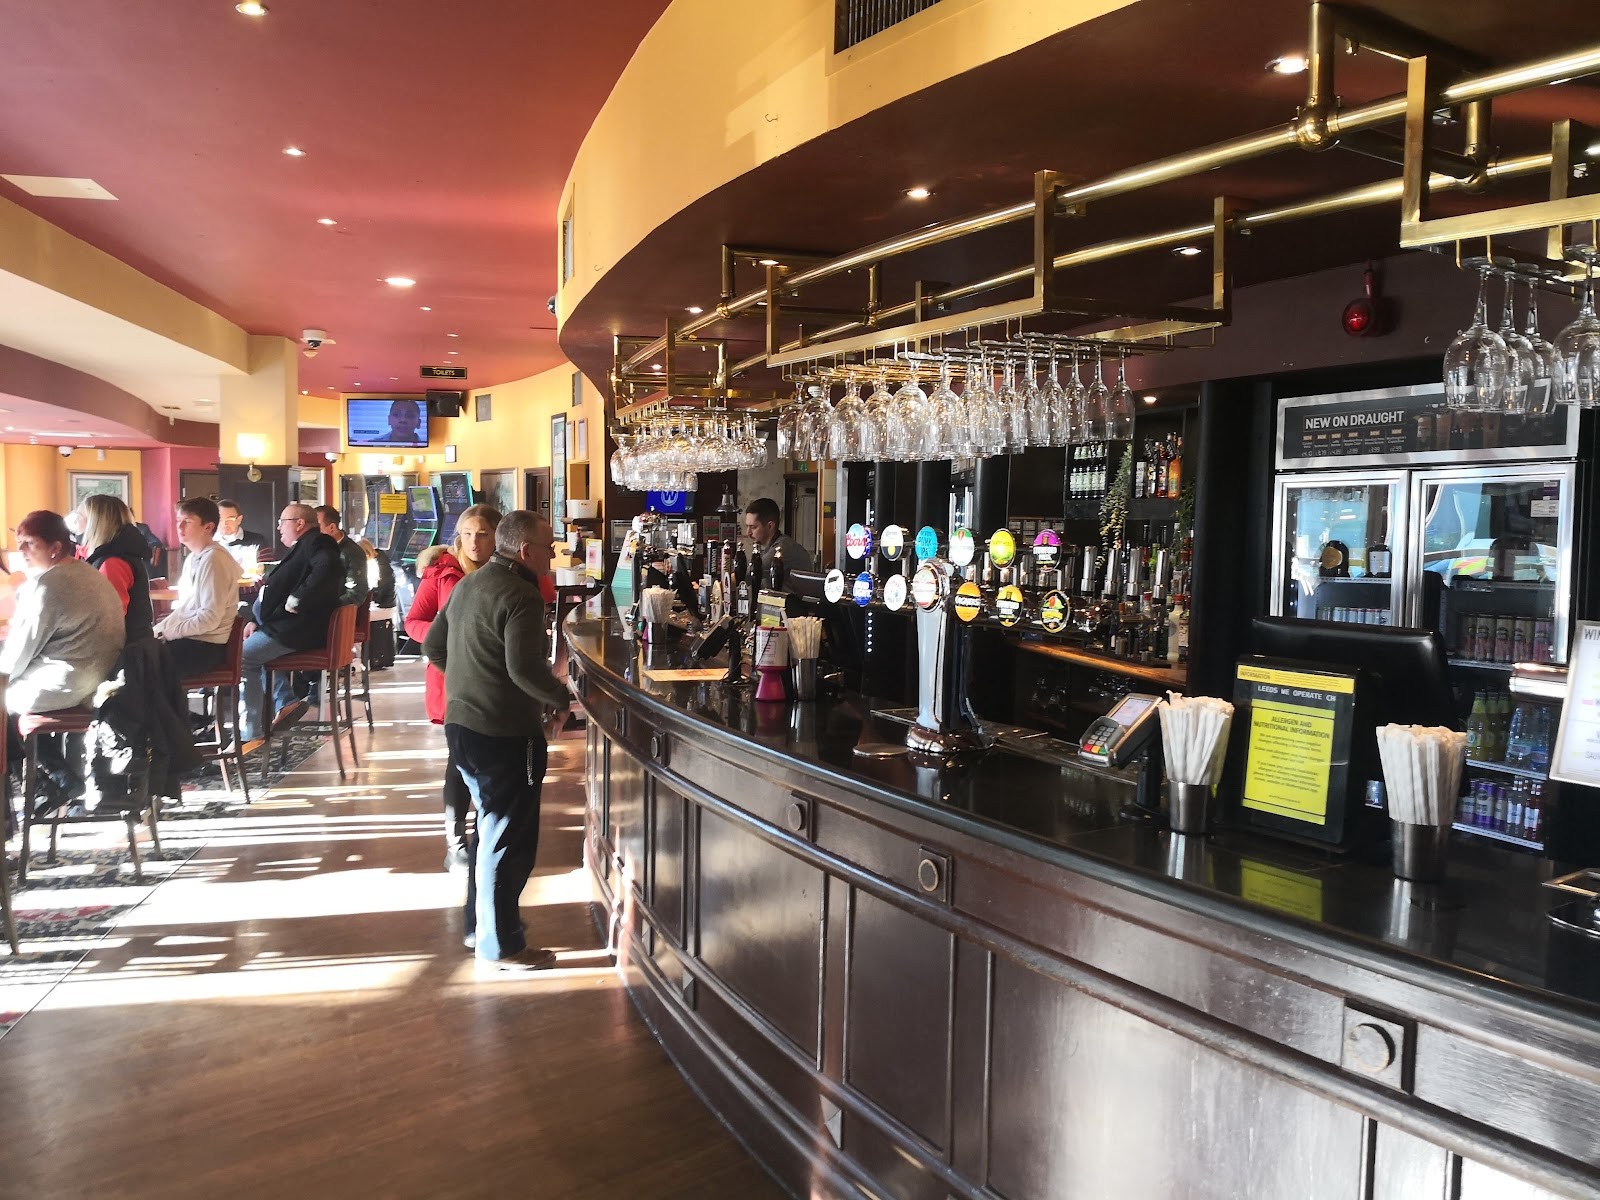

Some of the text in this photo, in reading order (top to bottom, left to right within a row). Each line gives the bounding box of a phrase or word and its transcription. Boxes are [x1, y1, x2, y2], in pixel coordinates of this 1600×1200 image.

[1305, 410, 1405, 429] NEW ON DRAUGHT
[1257, 685, 1278, 694] LEEDS
[1293, 691, 1323, 700] OPERATE
[1271, 716, 1298, 726] ALLERGEN
[1253, 721, 1330, 739] NUTRITIONAL INFORMATION
